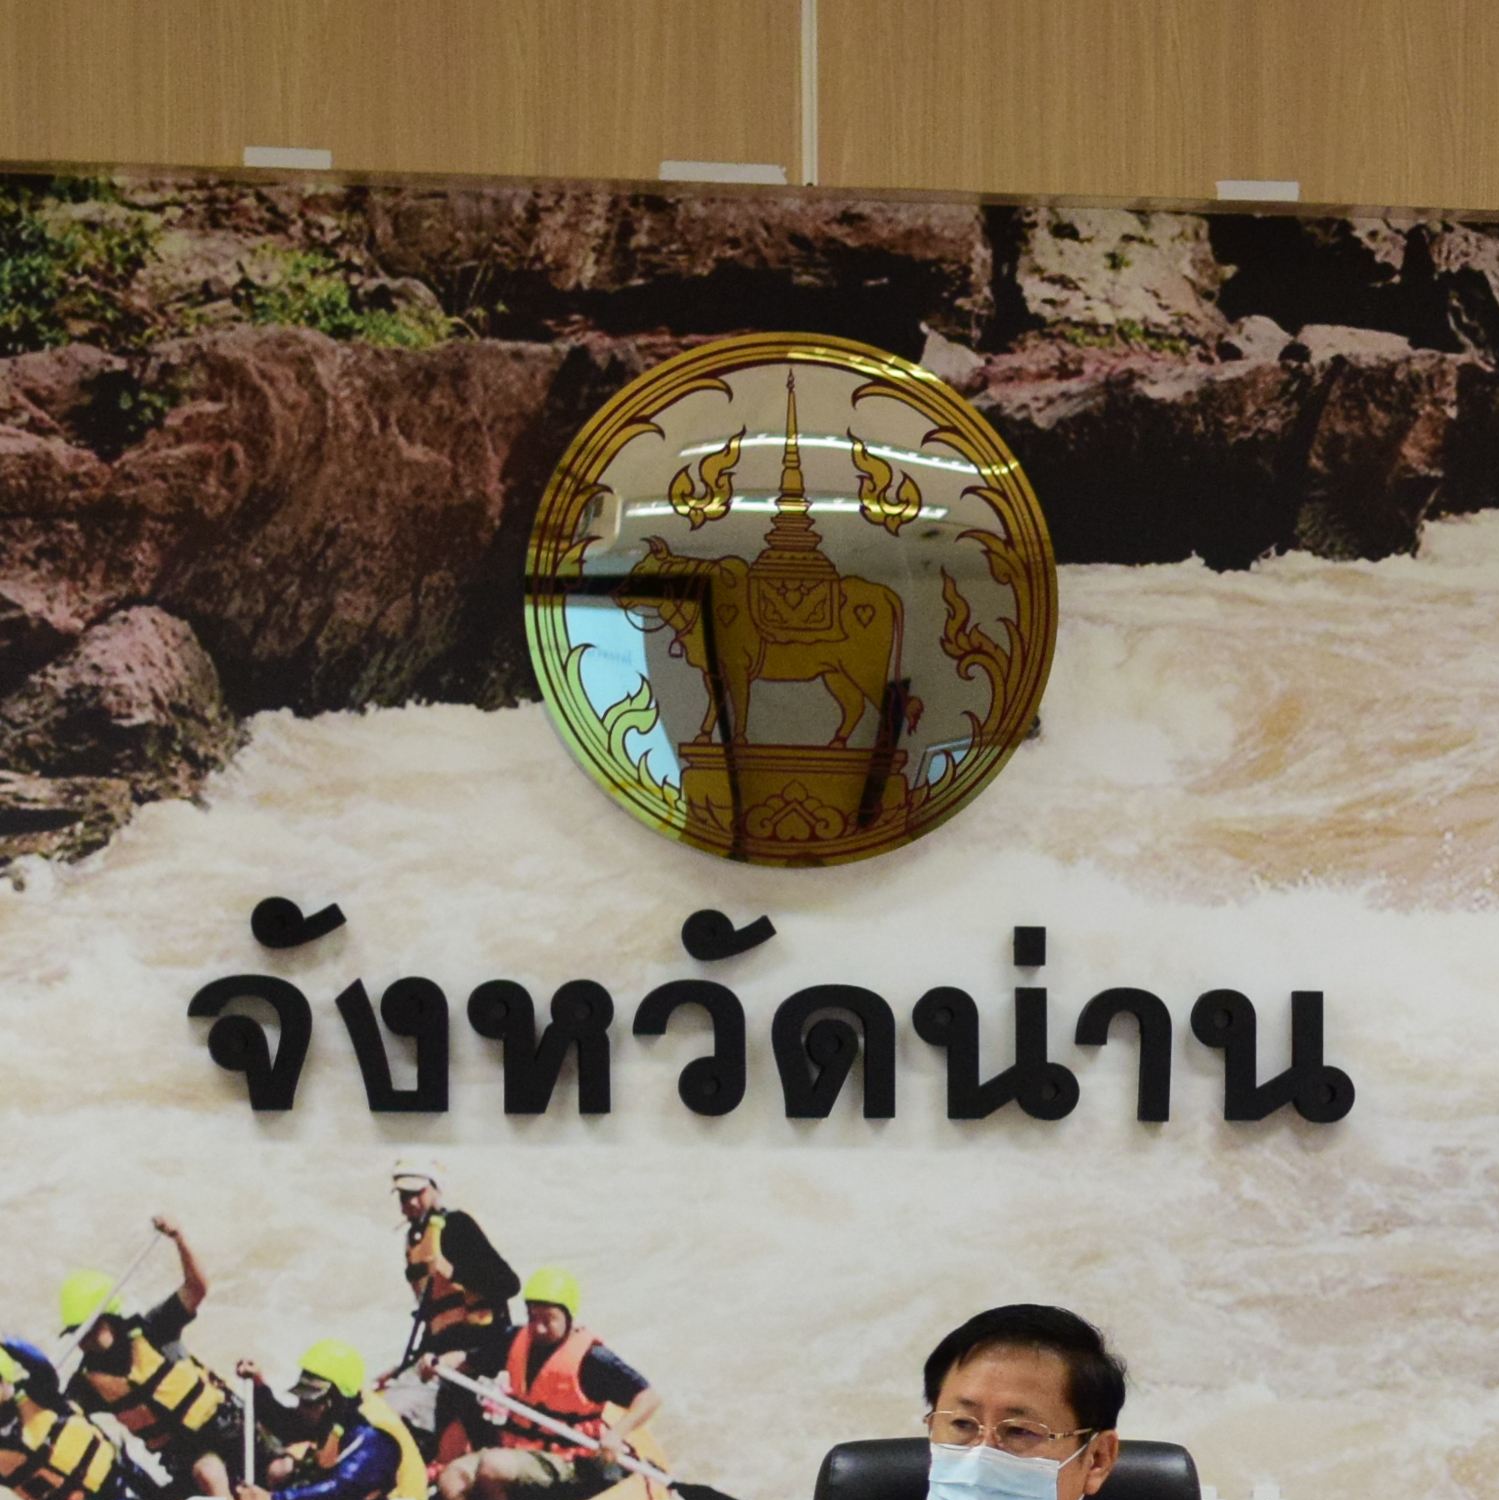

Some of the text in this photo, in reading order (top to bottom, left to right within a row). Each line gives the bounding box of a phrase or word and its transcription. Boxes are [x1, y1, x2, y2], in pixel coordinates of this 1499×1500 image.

[187, 897, 1356, 1124] จังหวัดน่าน
